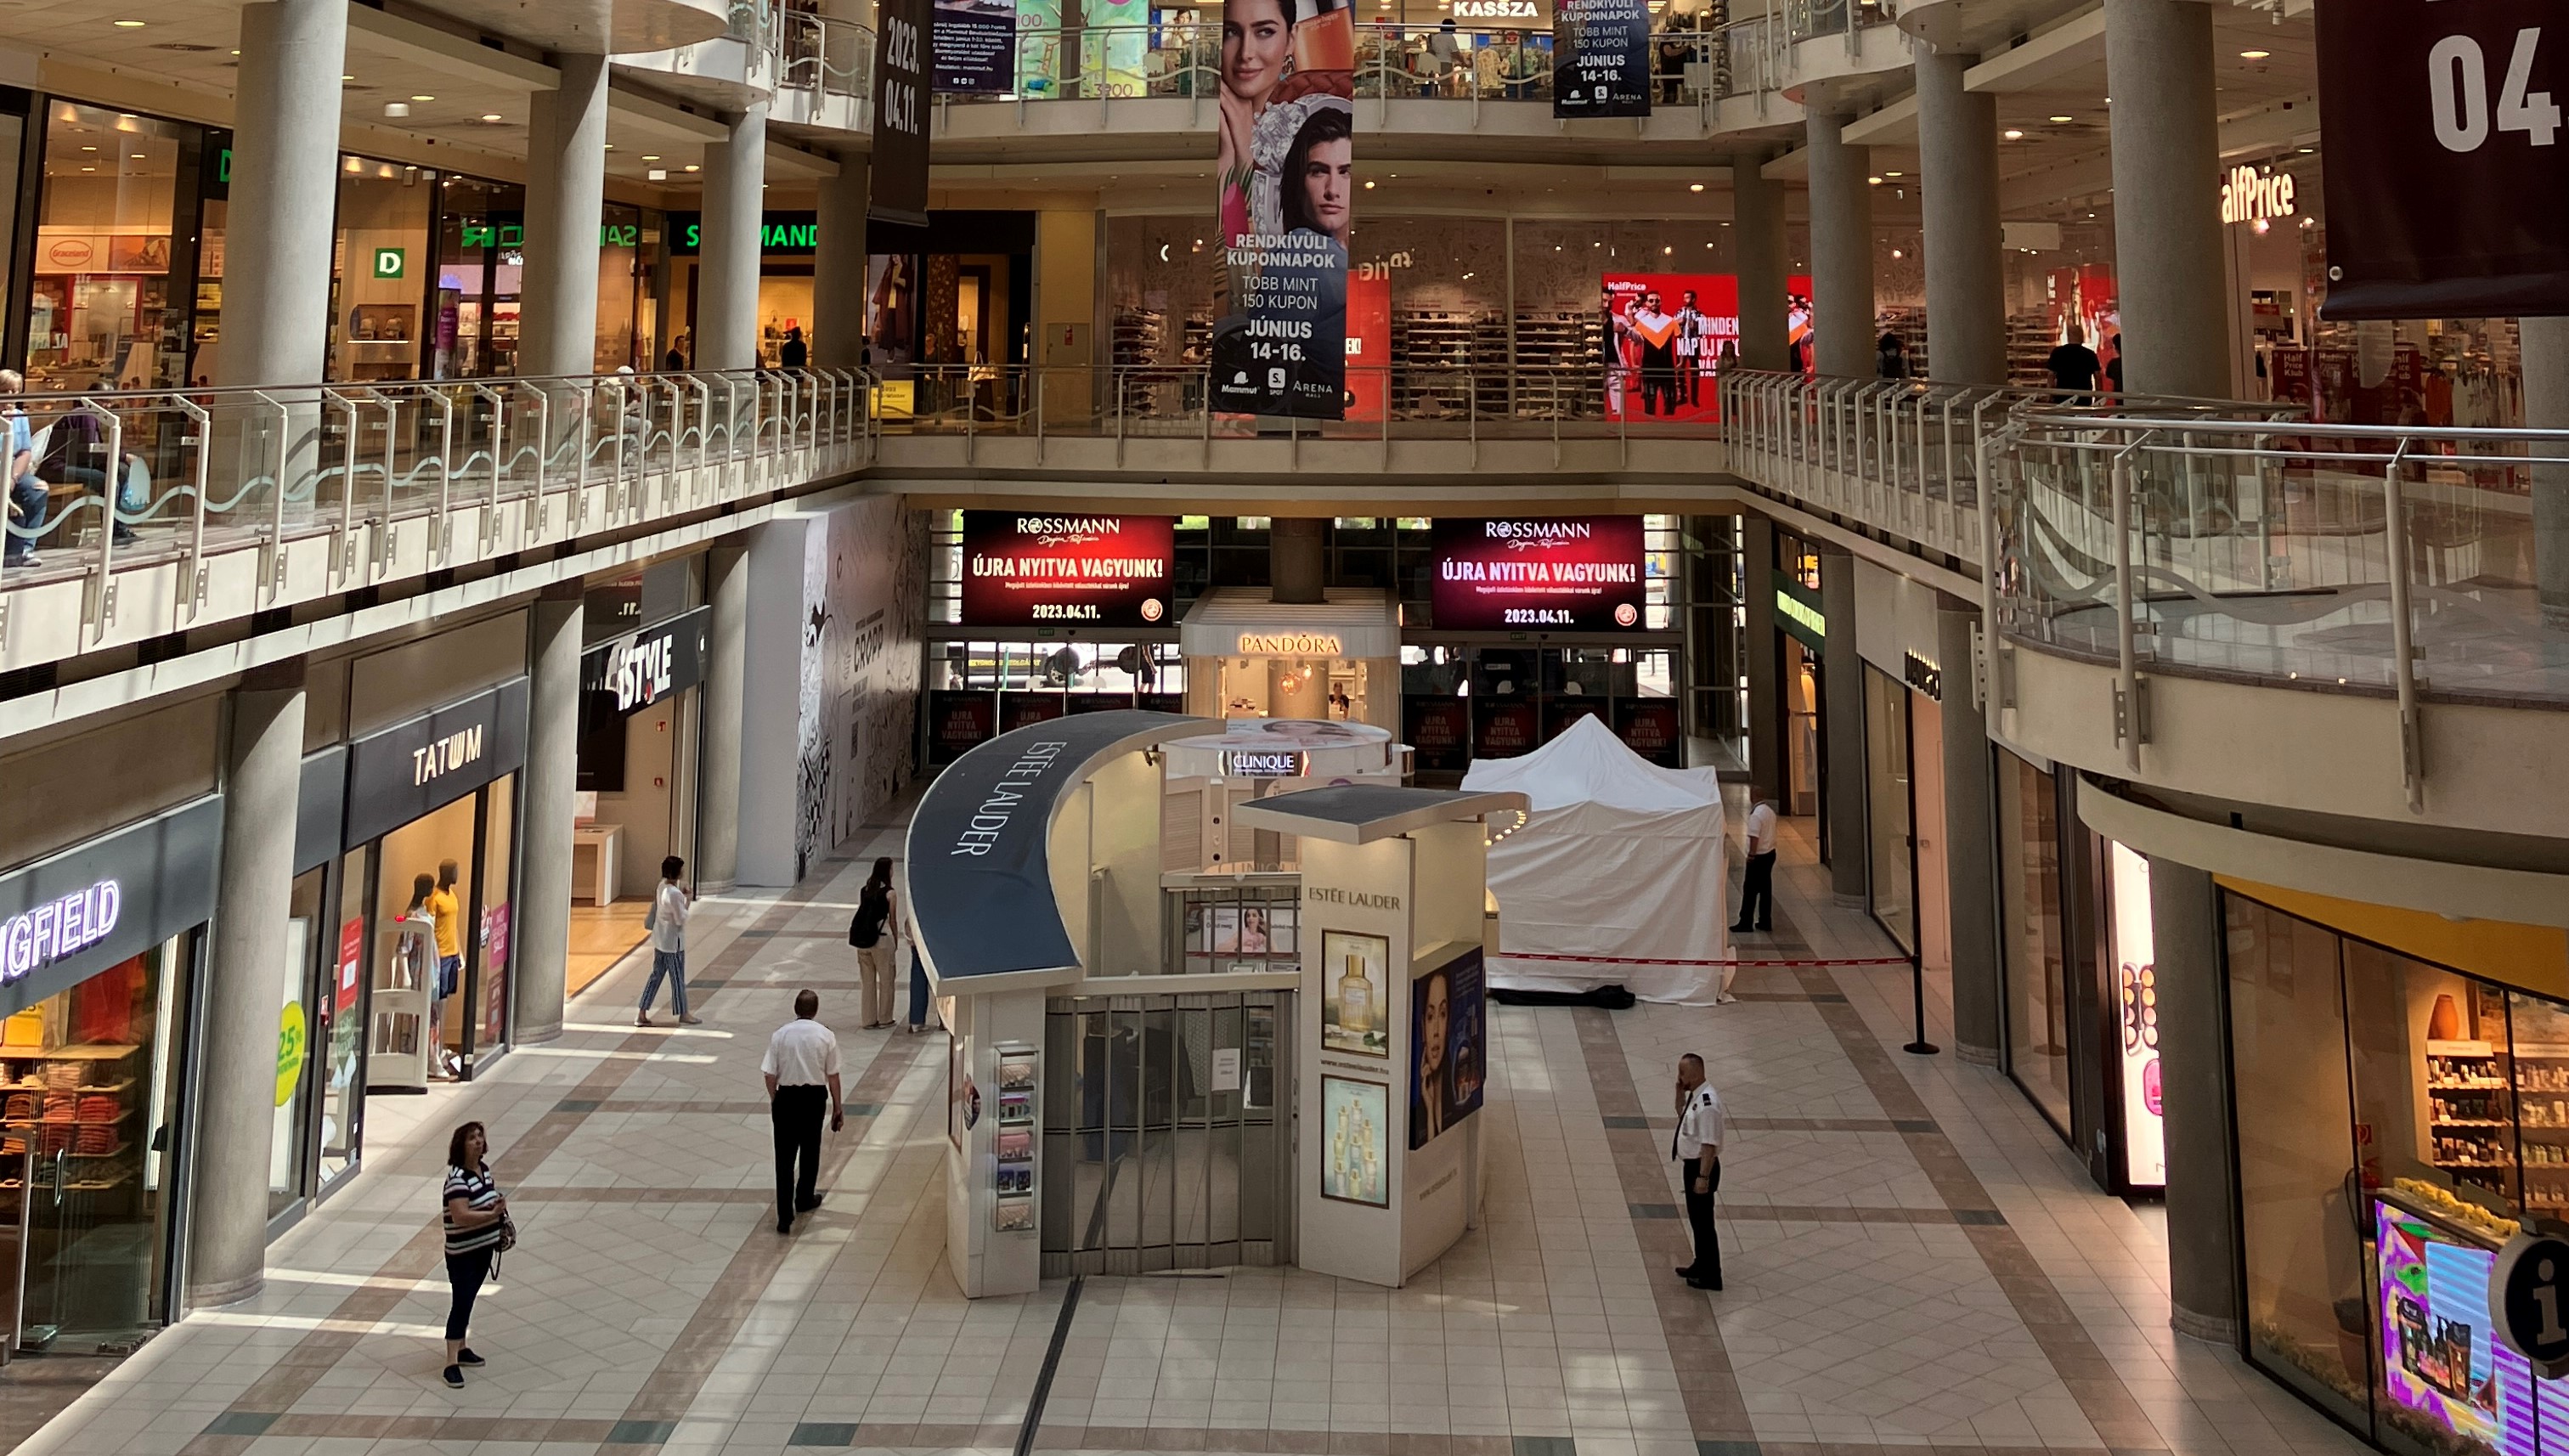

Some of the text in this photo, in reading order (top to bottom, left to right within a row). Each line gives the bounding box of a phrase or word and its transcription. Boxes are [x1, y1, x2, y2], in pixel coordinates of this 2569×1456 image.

[1454, 2, 1539, 17] KASSZA
[1561, 10, 1640, 22] KUPONNAPOK
[1602, 25, 1628, 36] MINT
[887, 16, 919, 75] 2023.
[1573, 38, 1629, 48] 150 KUPON
[1577, 52, 1625, 68] JÚNIUS
[1581, 71, 1622, 82] 14-16.
[885, 78, 918, 135] 04.11.
[2222, 165, 2294, 224] alfPrice
[1235, 231, 1328, 250] RENDKÍVÜLI
[1227, 251, 1335, 268] KUPONNAPOK
[1242, 274, 1318, 291] TÖBB MINT
[1608, 281, 1646, 291] HalfPrice
[1242, 294, 1318, 309] 150 KUPON
[1245, 315, 1313, 338] JÚNIUS
[1698, 316, 1740, 335] MINDEN
[1251, 341, 1307, 361] 14-16.
[1677, 337, 1698, 356] NAP
[1222, 384, 1258, 394] Mammut
[1293, 381, 1333, 393] ARENA
[1018, 518, 1120, 533] ROSSMANN
[1486, 522, 1590, 538] ROSSMANN
[973, 553, 1163, 578] ÚJRA NYITVA VAGYUNK!
[1443, 557, 1636, 583] ÚJRA NYITVA VAGYUNK!
[1033, 604, 1101, 618] 2023.04.11.
[1505, 609, 1574, 624] 2023.04.11.
[854, 623, 884, 673] CROPP
[1234, 755, 1294, 769] CLINIQUE
[950, 782, 1032, 856] LAUDER
[1309, 887, 1401, 911] ESTÉE LAUDER
